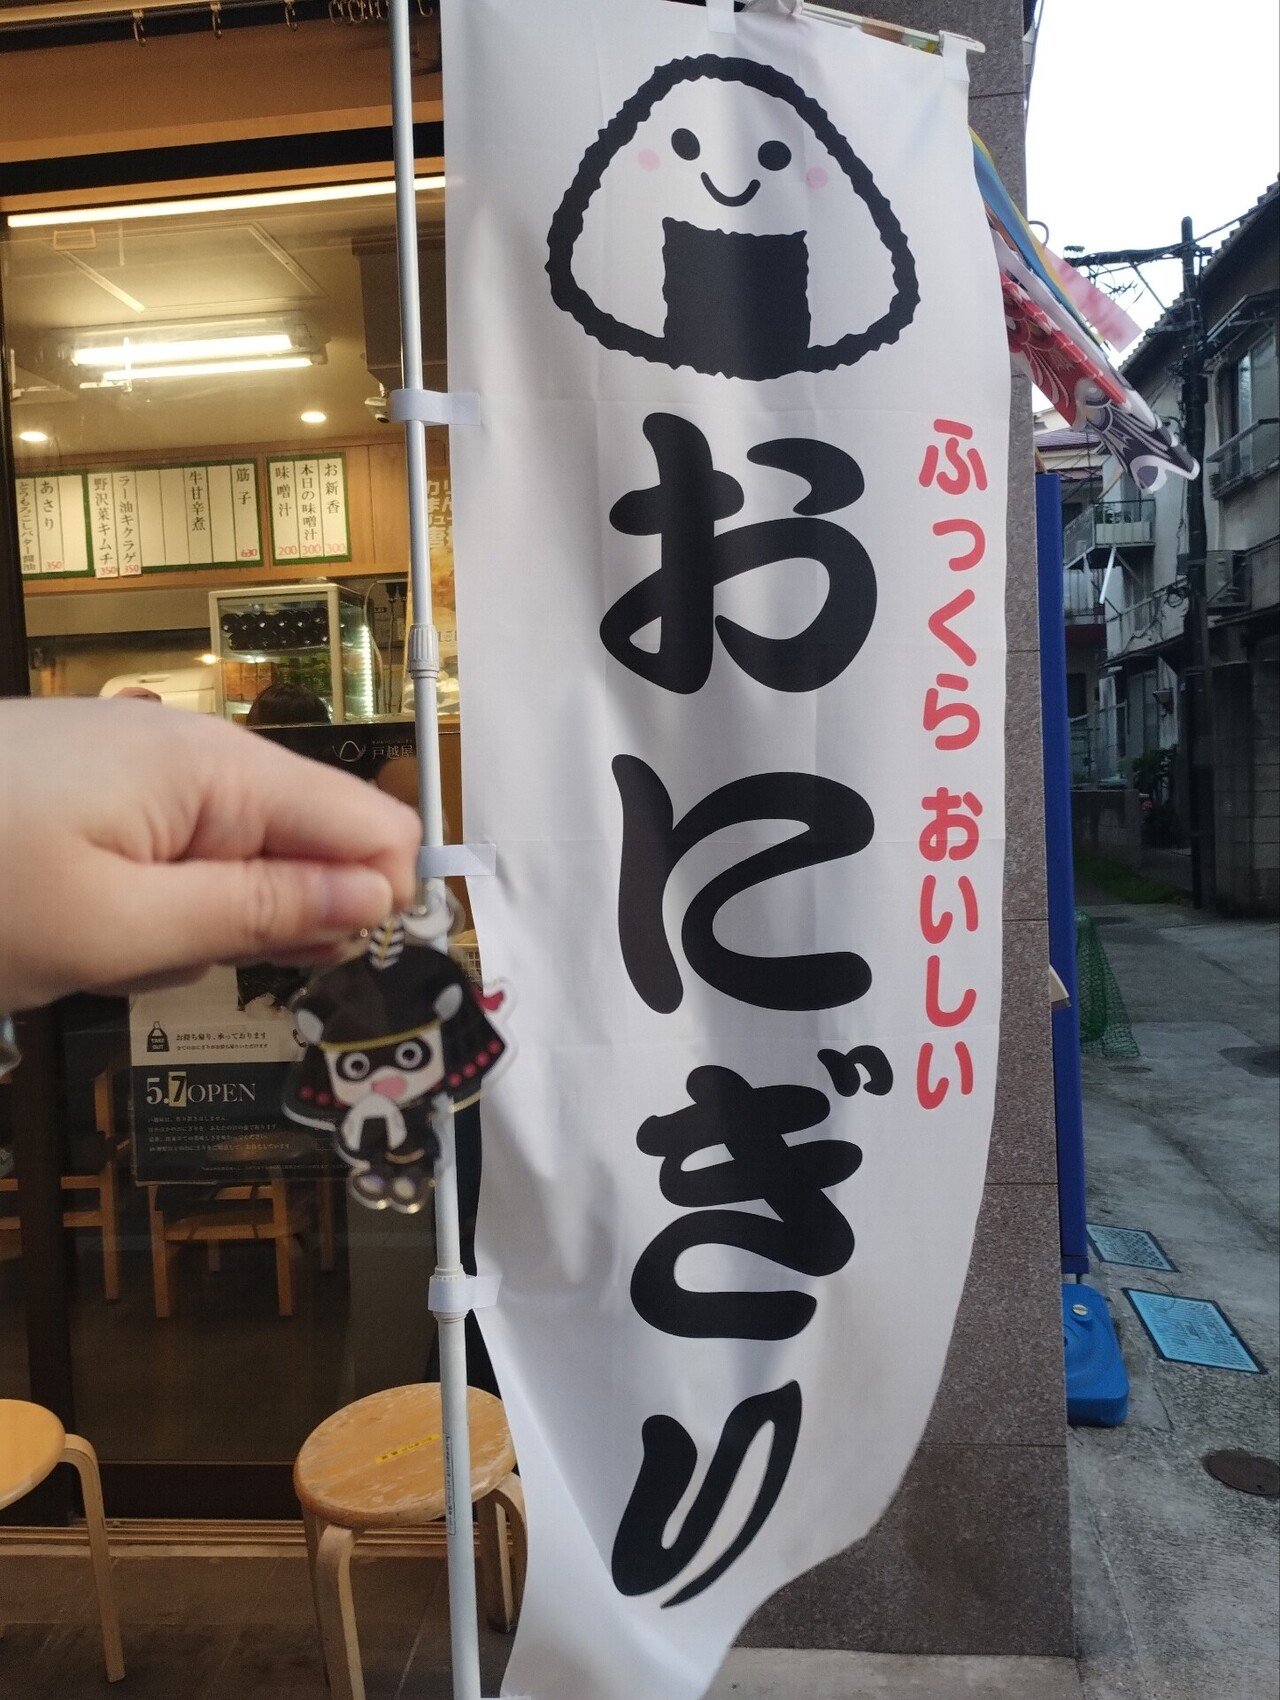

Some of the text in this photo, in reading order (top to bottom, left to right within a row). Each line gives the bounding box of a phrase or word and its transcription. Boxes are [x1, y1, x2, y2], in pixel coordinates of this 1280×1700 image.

[40, 480, 55, 530] あさり
[188, 470, 206, 531] 牛甘辛煮
[236, 468, 251, 505] 筋子
[275, 465, 291, 517] 味噌汁
[301, 464, 318, 541] 本日の味噌汁
[324, 463, 340, 514] お新香
[94, 477, 114, 565] 野沢菜キムチ
[119, 475, 136, 563] ラー油キクラゲ
[46, 561, 62, 570] 350
[100, 565, 117, 575] 350
[124, 564, 139, 573] 350
[278, 545, 298, 556] 200
[301, 543, 322, 555] 300
[326, 543, 346, 553] 300
[915, 418, 988, 1110] ふっくら おいしい
[599, 412, 894, 1609] おにぎり
